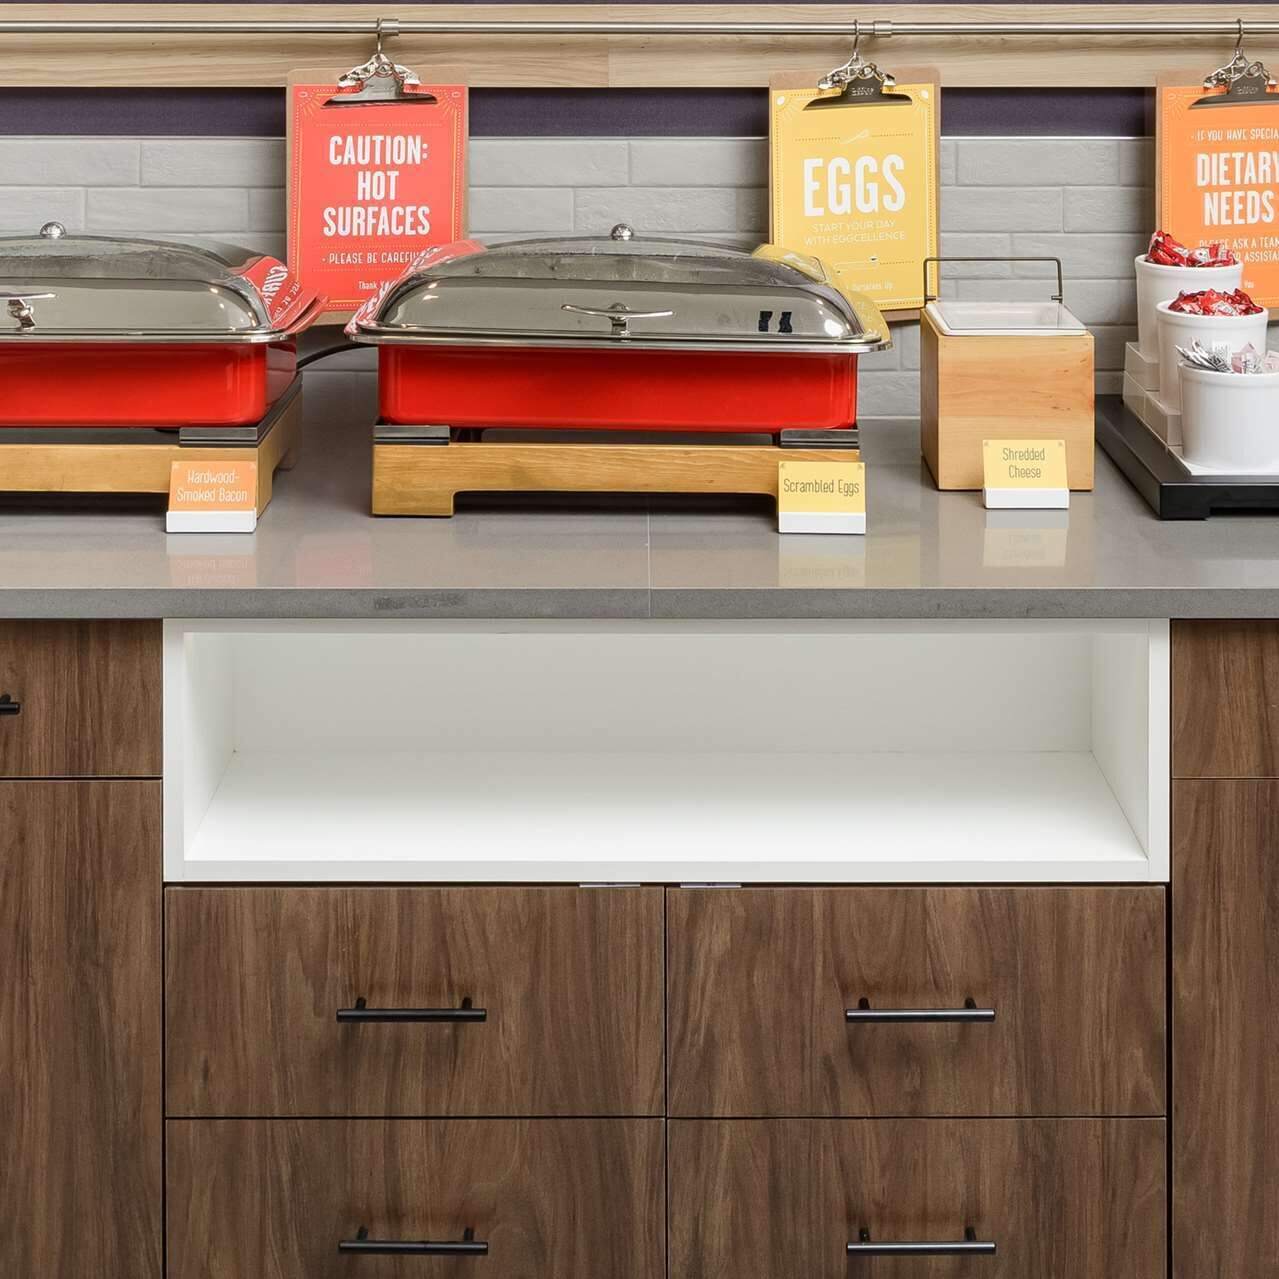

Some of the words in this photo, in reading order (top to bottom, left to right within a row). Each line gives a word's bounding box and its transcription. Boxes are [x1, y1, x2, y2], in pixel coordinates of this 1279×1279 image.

[1207, 128, 1223, 141] YOU
[1226, 128, 1247, 141] HAVE
[329, 134, 429, 166] CAUTION:
[357, 170, 400, 201] HOT
[803, 153, 906, 217] EGGS
[1204, 190, 1275, 226] NEEDS
[323, 206, 431, 237] SURFACES
[813, 222, 843, 233] START
[847, 221, 873, 231] YOUR
[875, 219, 896, 229] DAY
[804, 235, 831, 246] WITH
[833, 231, 905, 244] EGGCELLENCE
[1232, 238, 1249, 250] ASK
[1251, 237, 1257, 249] A
[329, 252, 363, 265] PLEASE
[367, 252, 378, 264] BE
[1002, 447, 1046, 462] Shredded
[187, 469, 240, 485] Hardwood-
[1008, 465, 1042, 479] Cheese
[176, 487, 216, 503] Smoked
[219, 487, 248, 503] Bacon
[783, 479, 835, 494] Scrambled
[838, 478, 860, 498] Eggs
